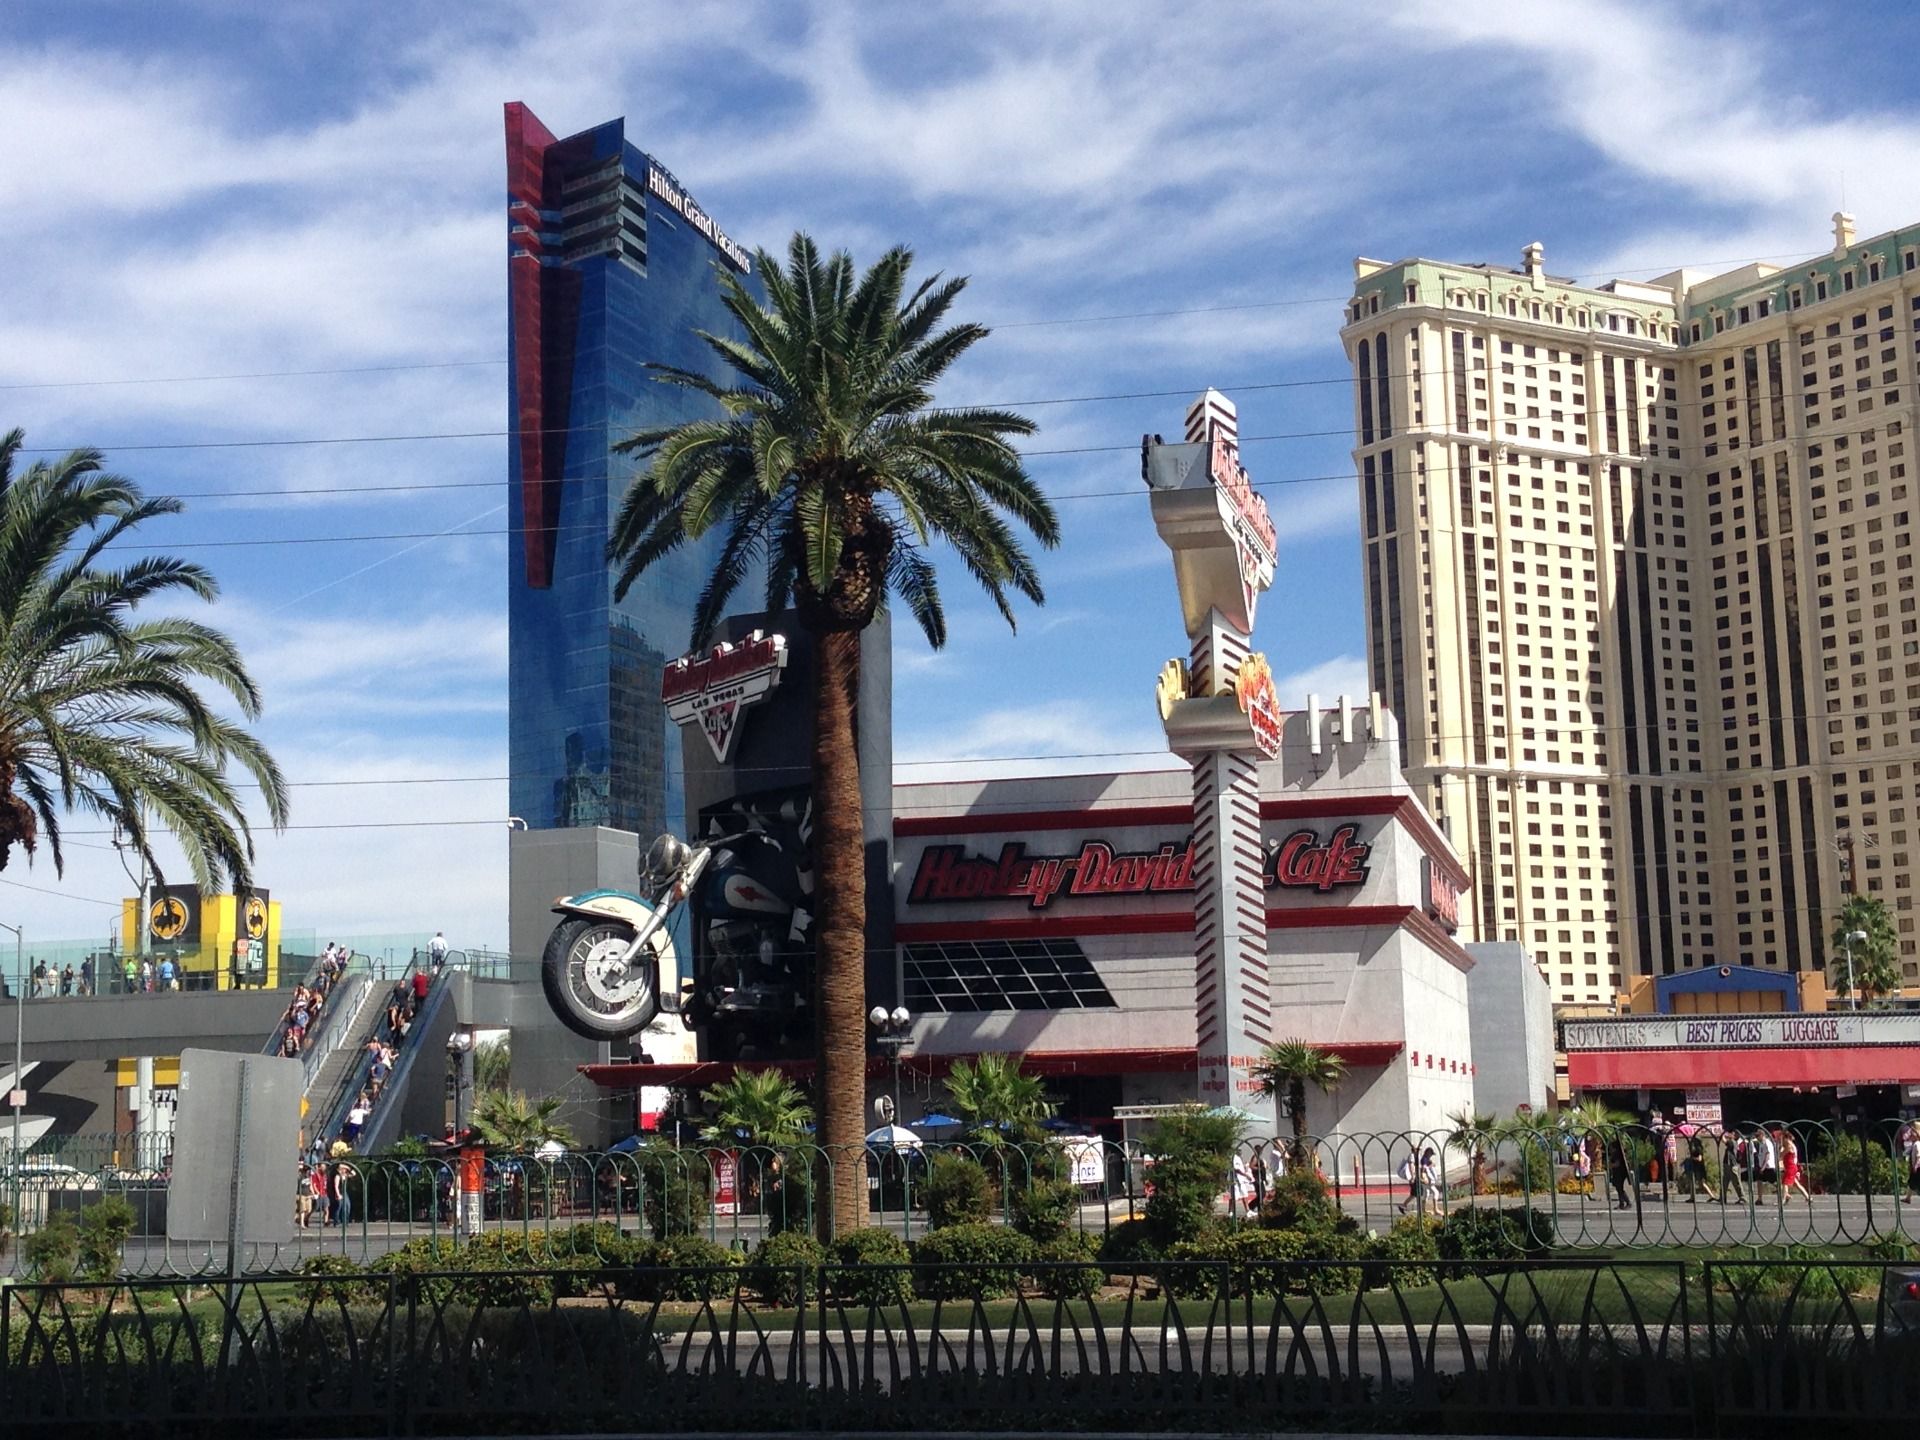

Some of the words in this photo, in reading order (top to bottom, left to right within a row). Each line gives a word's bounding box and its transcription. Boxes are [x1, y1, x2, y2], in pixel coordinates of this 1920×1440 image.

[649, 167, 682, 212] Hilton
[684, 197, 712, 238] Grand
[713, 220, 750, 275] Vacations
[692, 698, 709, 709] LAS
[713, 686, 744, 702] VEGAS
[1071, 840, 1197, 894] David
[1686, 1022, 1718, 1044] BEST
[1719, 1021, 1762, 1043] PRICES
[1781, 1019, 1840, 1042] LUGGAGE
